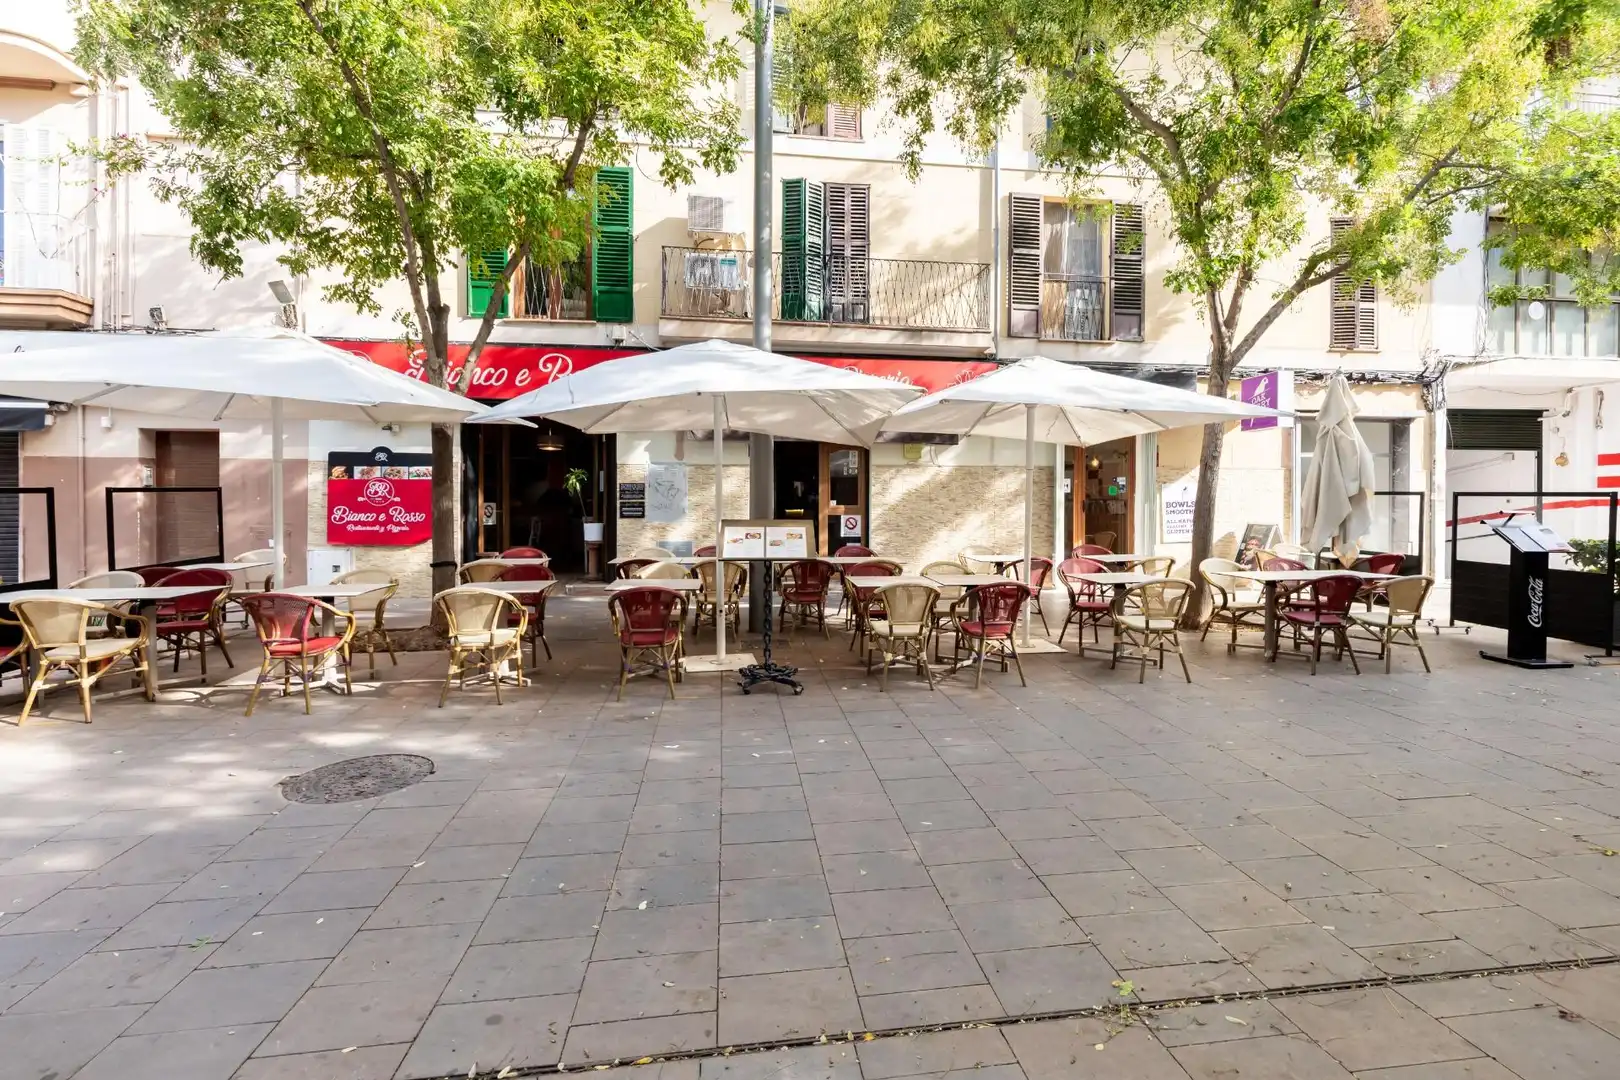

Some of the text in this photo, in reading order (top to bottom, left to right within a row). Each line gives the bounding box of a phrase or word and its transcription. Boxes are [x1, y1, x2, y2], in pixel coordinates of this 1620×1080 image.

[514, 368, 532, 387] e
[331, 506, 426, 524] Bianco e Rosso
